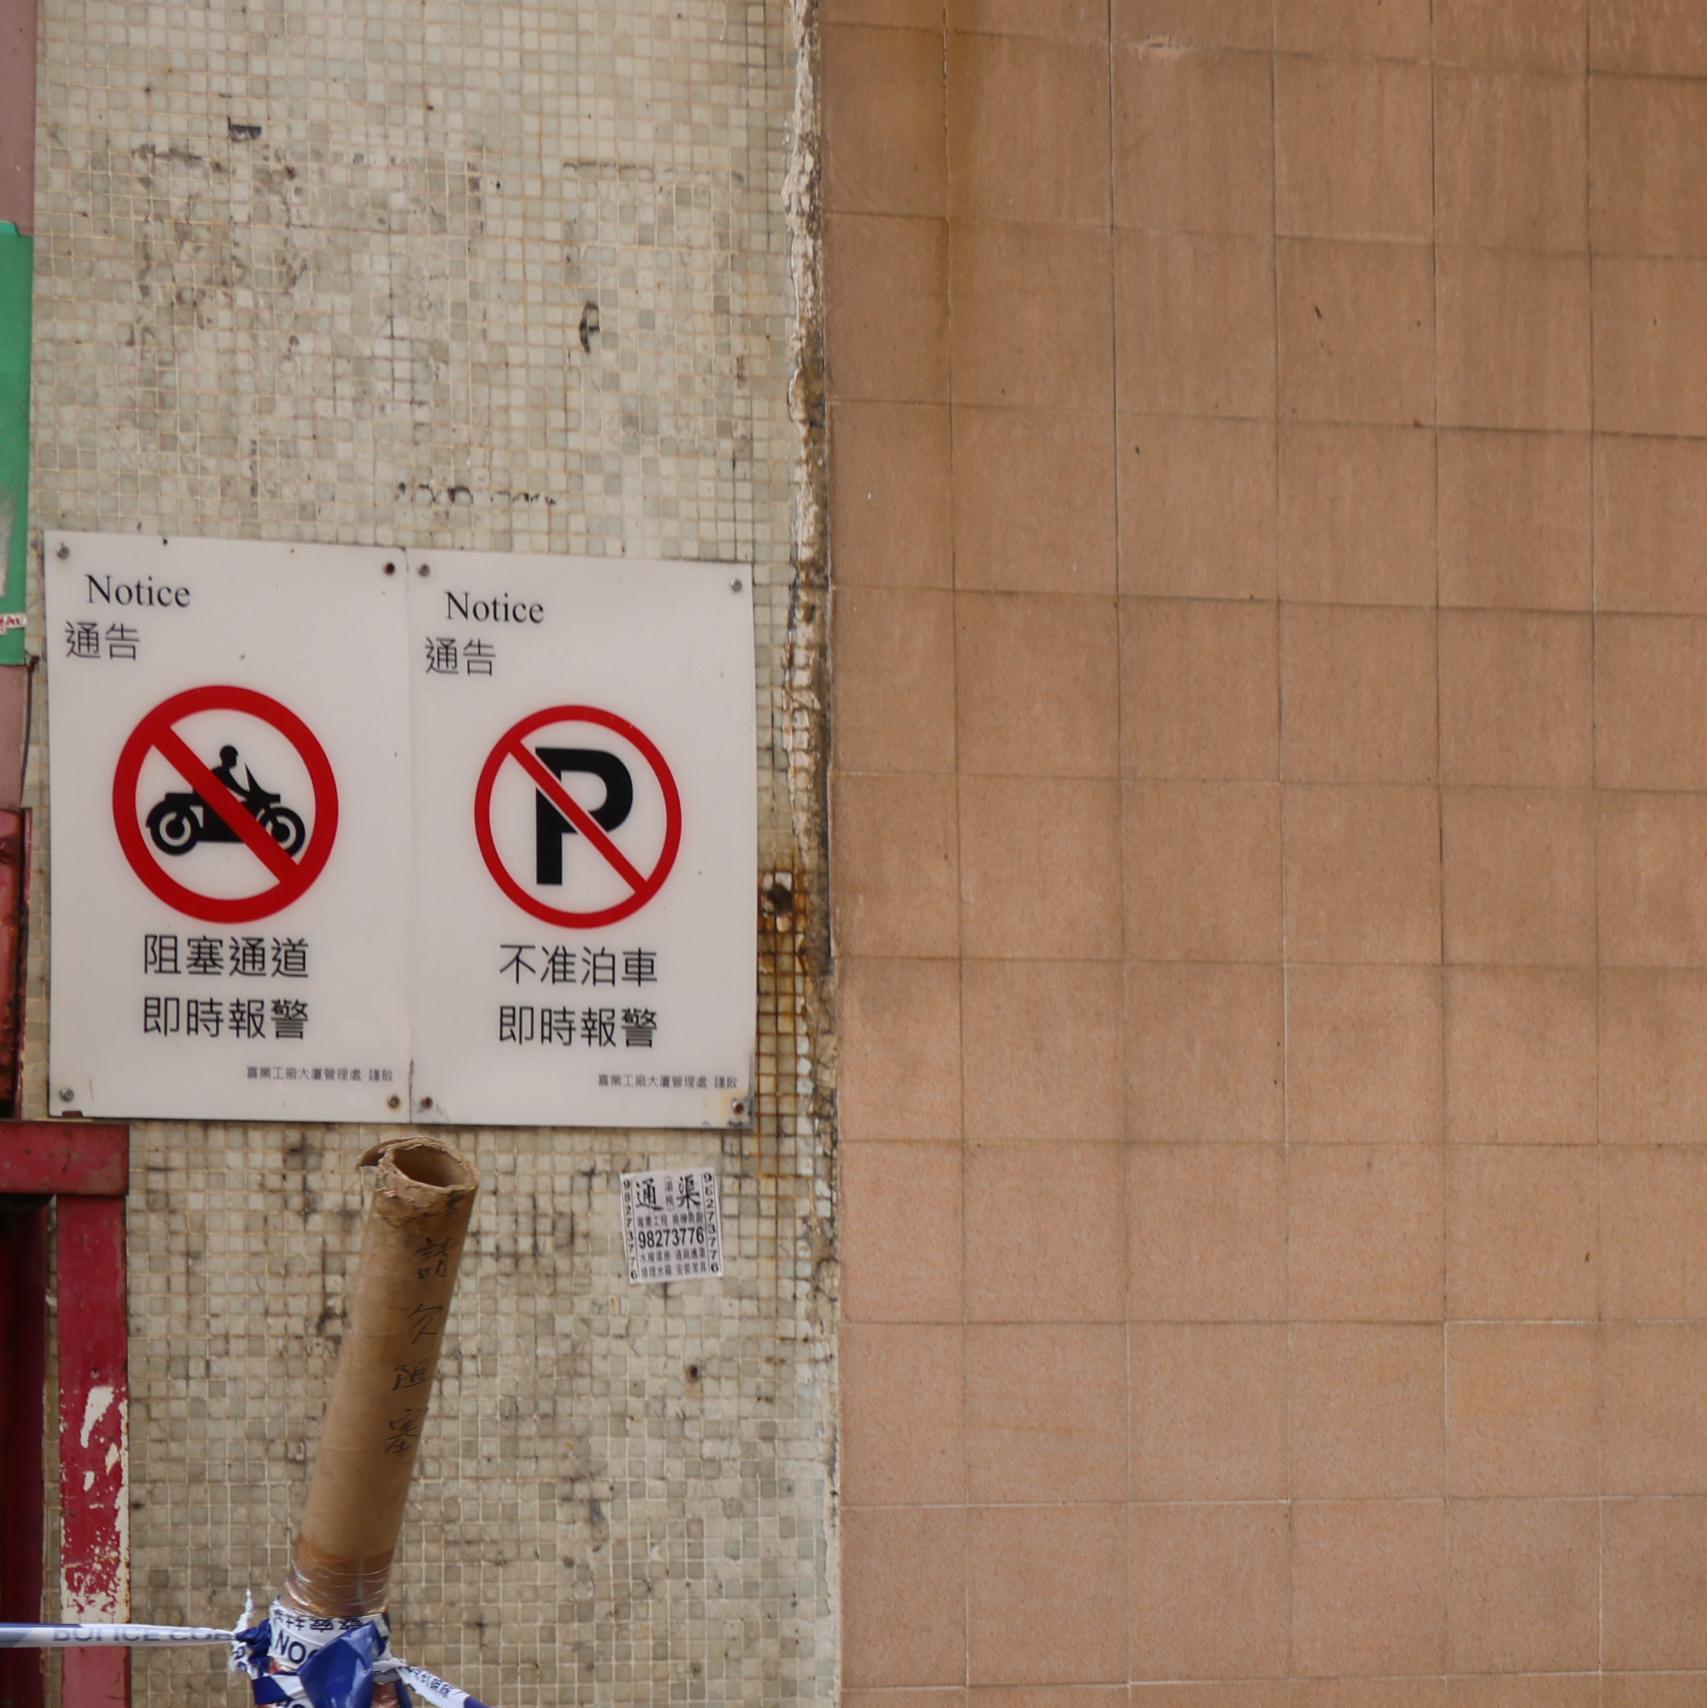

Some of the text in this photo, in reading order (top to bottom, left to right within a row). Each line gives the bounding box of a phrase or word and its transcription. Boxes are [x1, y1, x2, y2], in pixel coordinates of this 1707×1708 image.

[86, 573, 191, 610] Notice
[446, 591, 545, 626] Notice
[65, 620, 140, 662] 通告
[425, 638, 497, 677] 通告
[143, 935, 310, 980] 阻塞通道
[499, 943, 659, 987] 不准泊車
[143, 997, 310, 1040] 即時報警
[498, 1006, 659, 1050] 即時報警
[637, 1226, 705, 1249] 98273776
